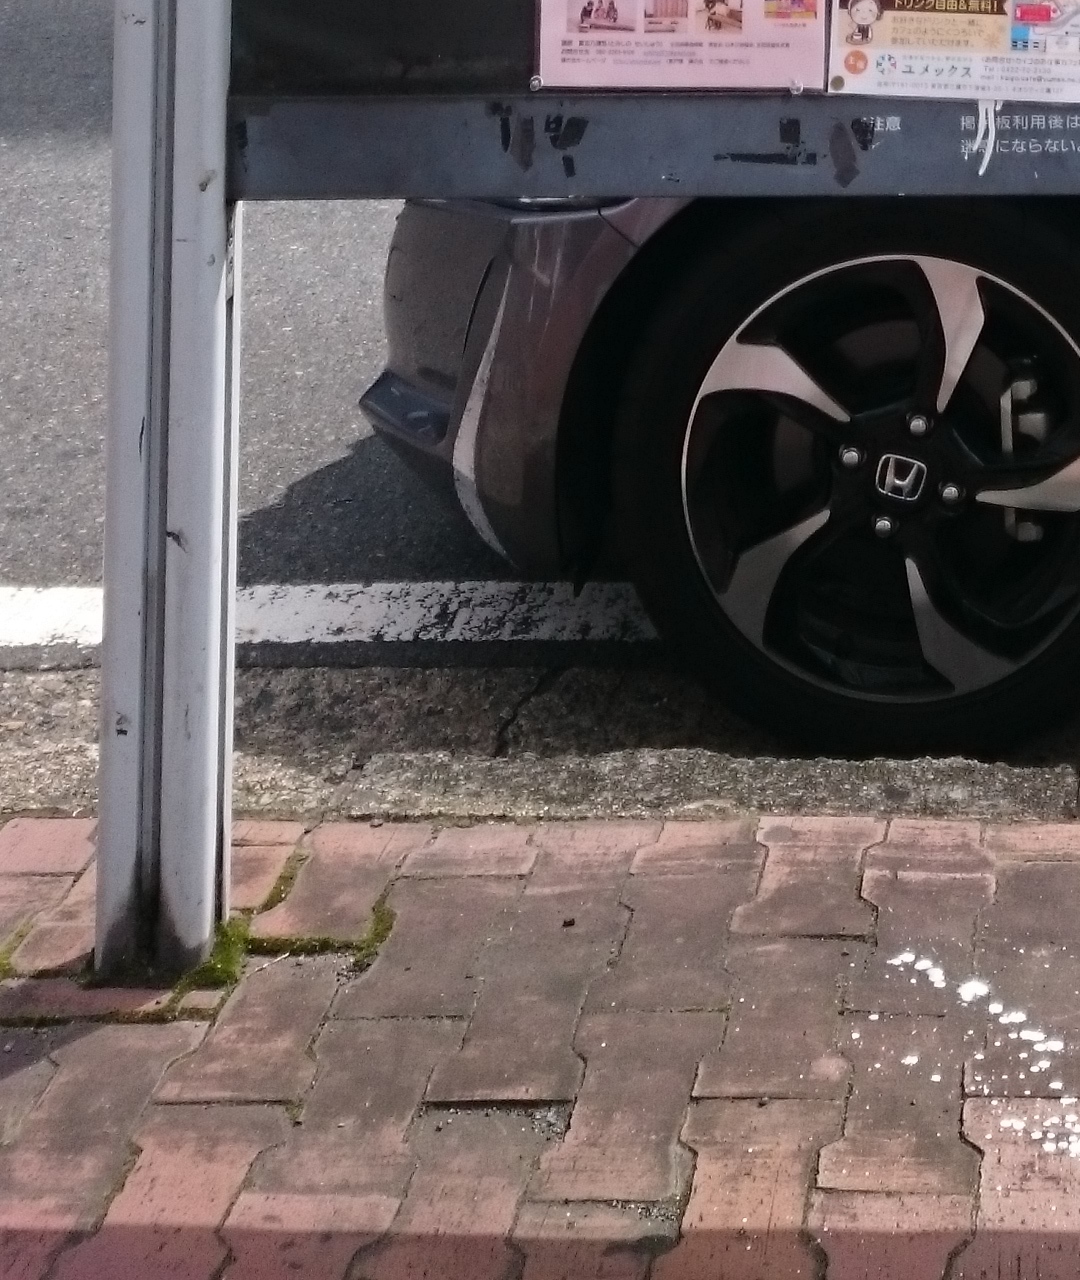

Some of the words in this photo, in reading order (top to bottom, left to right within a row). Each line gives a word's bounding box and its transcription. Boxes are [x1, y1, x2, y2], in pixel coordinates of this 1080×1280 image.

[901, 62, 972, 79] ユメックス
